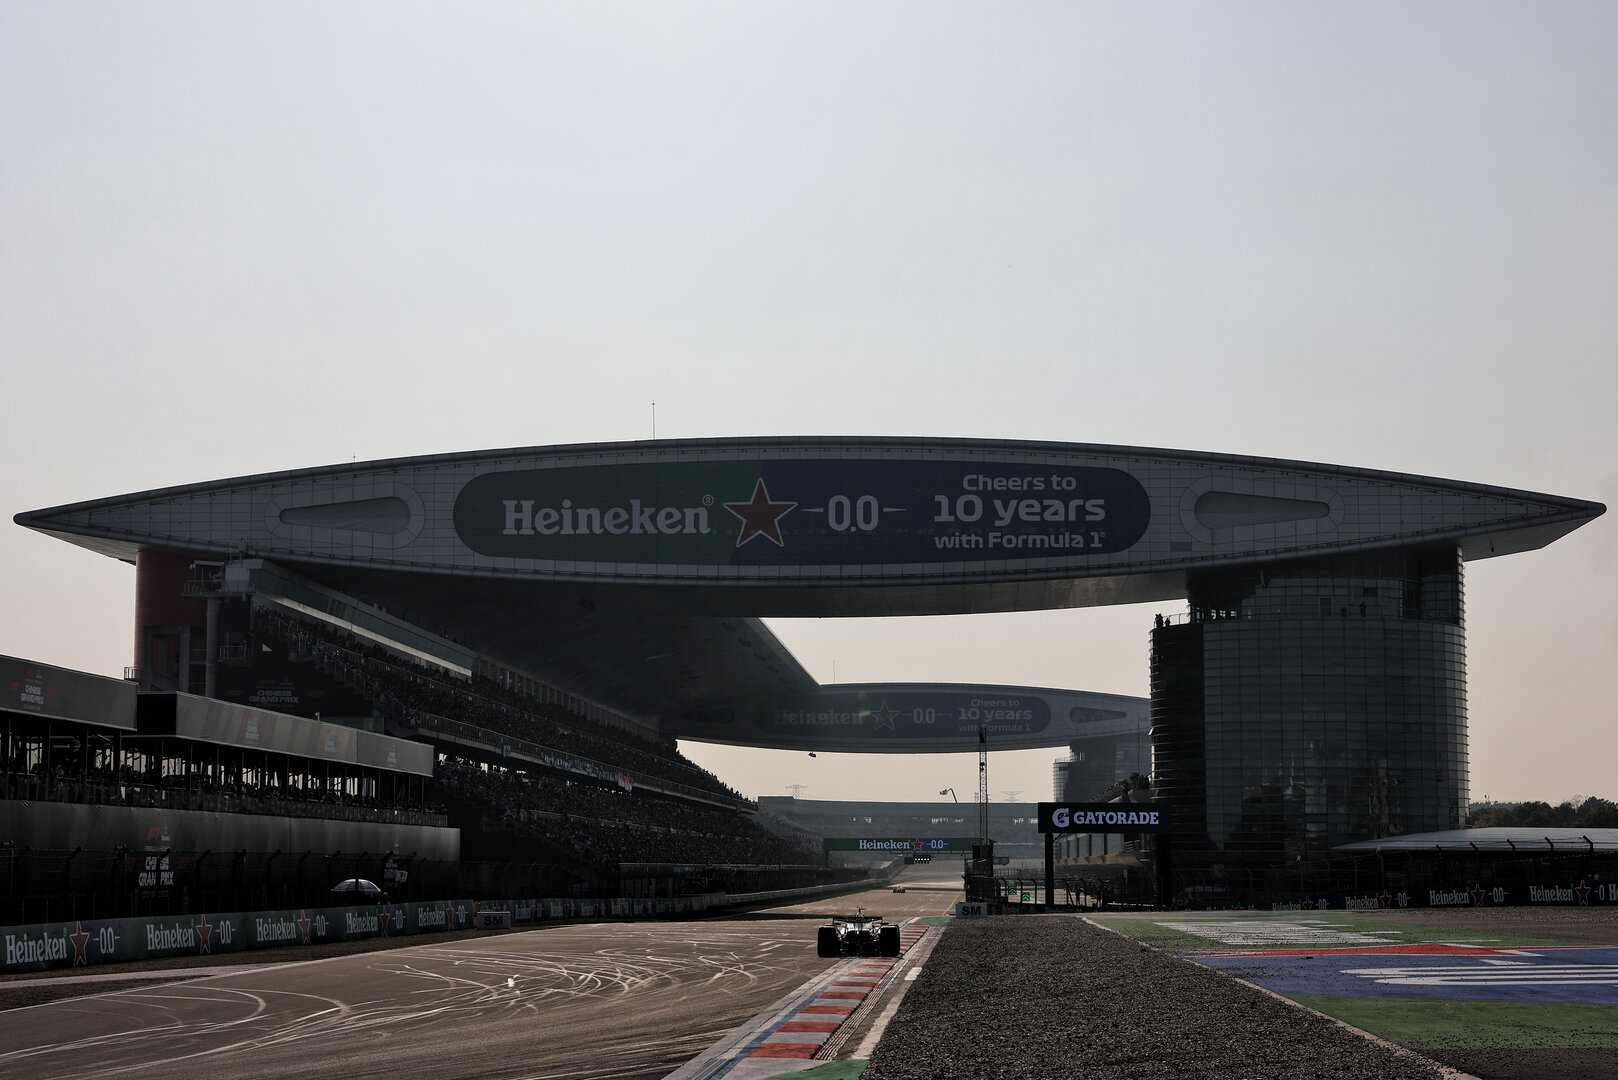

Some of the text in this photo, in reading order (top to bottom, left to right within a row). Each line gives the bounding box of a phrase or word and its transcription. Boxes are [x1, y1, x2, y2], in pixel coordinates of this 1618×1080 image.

[963, 474, 1077, 491] Cheers to
[828, 495, 879, 532] 0.0
[934, 495, 1106, 526] 10 years
[934, 532, 983, 548] with
[988, 532, 1084, 548] Formula
[970, 698, 1020, 707] Cheers to
[913, 707, 936, 725] 0.0
[958, 707, 1033, 722] 10 years
[1073, 811, 1159, 825] GATORADE
[859, 839, 910, 849] Heineken
[1429, 888, 1470, 906] Heineken
[1529, 884, 1574, 901] Heineken
[1345, 894, 1379, 910] Heineken
[418, 906, 446, 928] Heineken
[962, 906, 981, 916] SM
[256, 916, 296, 942] Heineken
[346, 910, 379, 934] Heineken
[484, 916, 503, 926] SM
[145, 923, 195, 951] Heineken
[5, 932, 67, 965] Heineken
